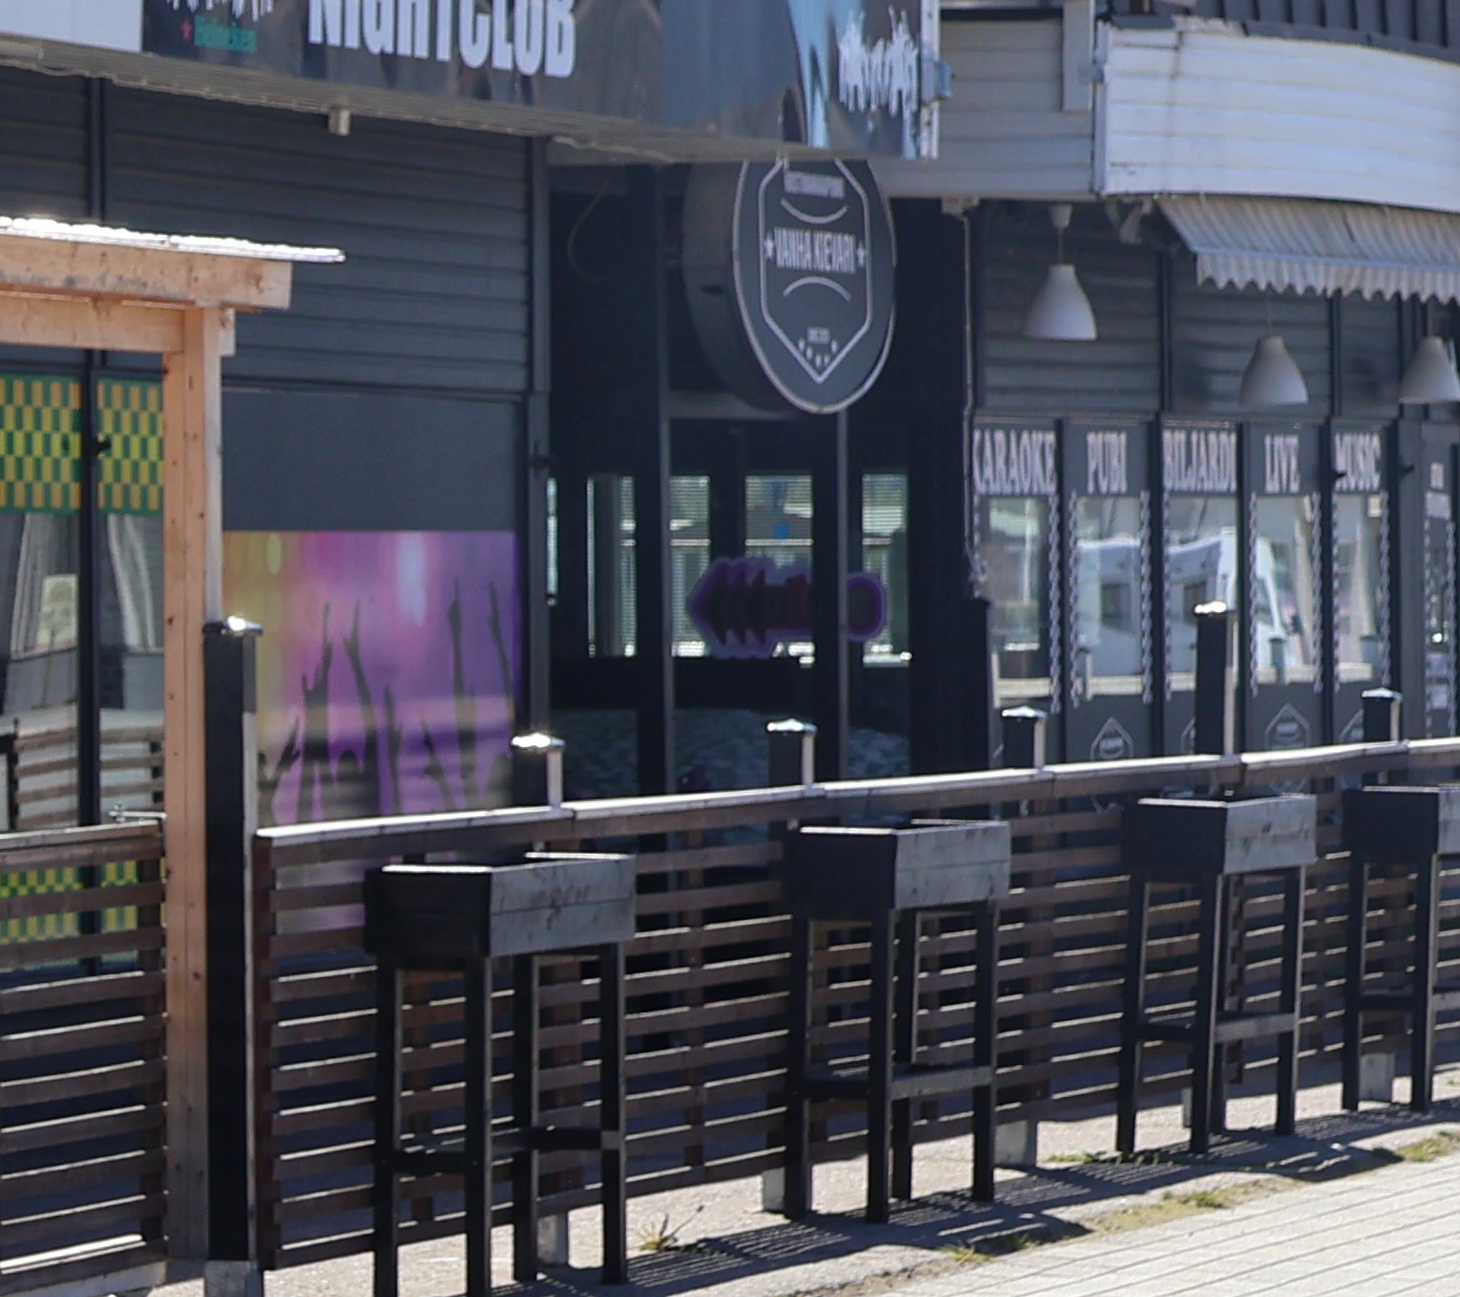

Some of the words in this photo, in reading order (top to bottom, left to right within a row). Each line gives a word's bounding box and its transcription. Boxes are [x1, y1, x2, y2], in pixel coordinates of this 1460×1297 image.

[1086, 431, 1127, 495] PUBI
[1162, 429, 1237, 494] BILJARDI
[1264, 433, 1300, 495] LIVE
